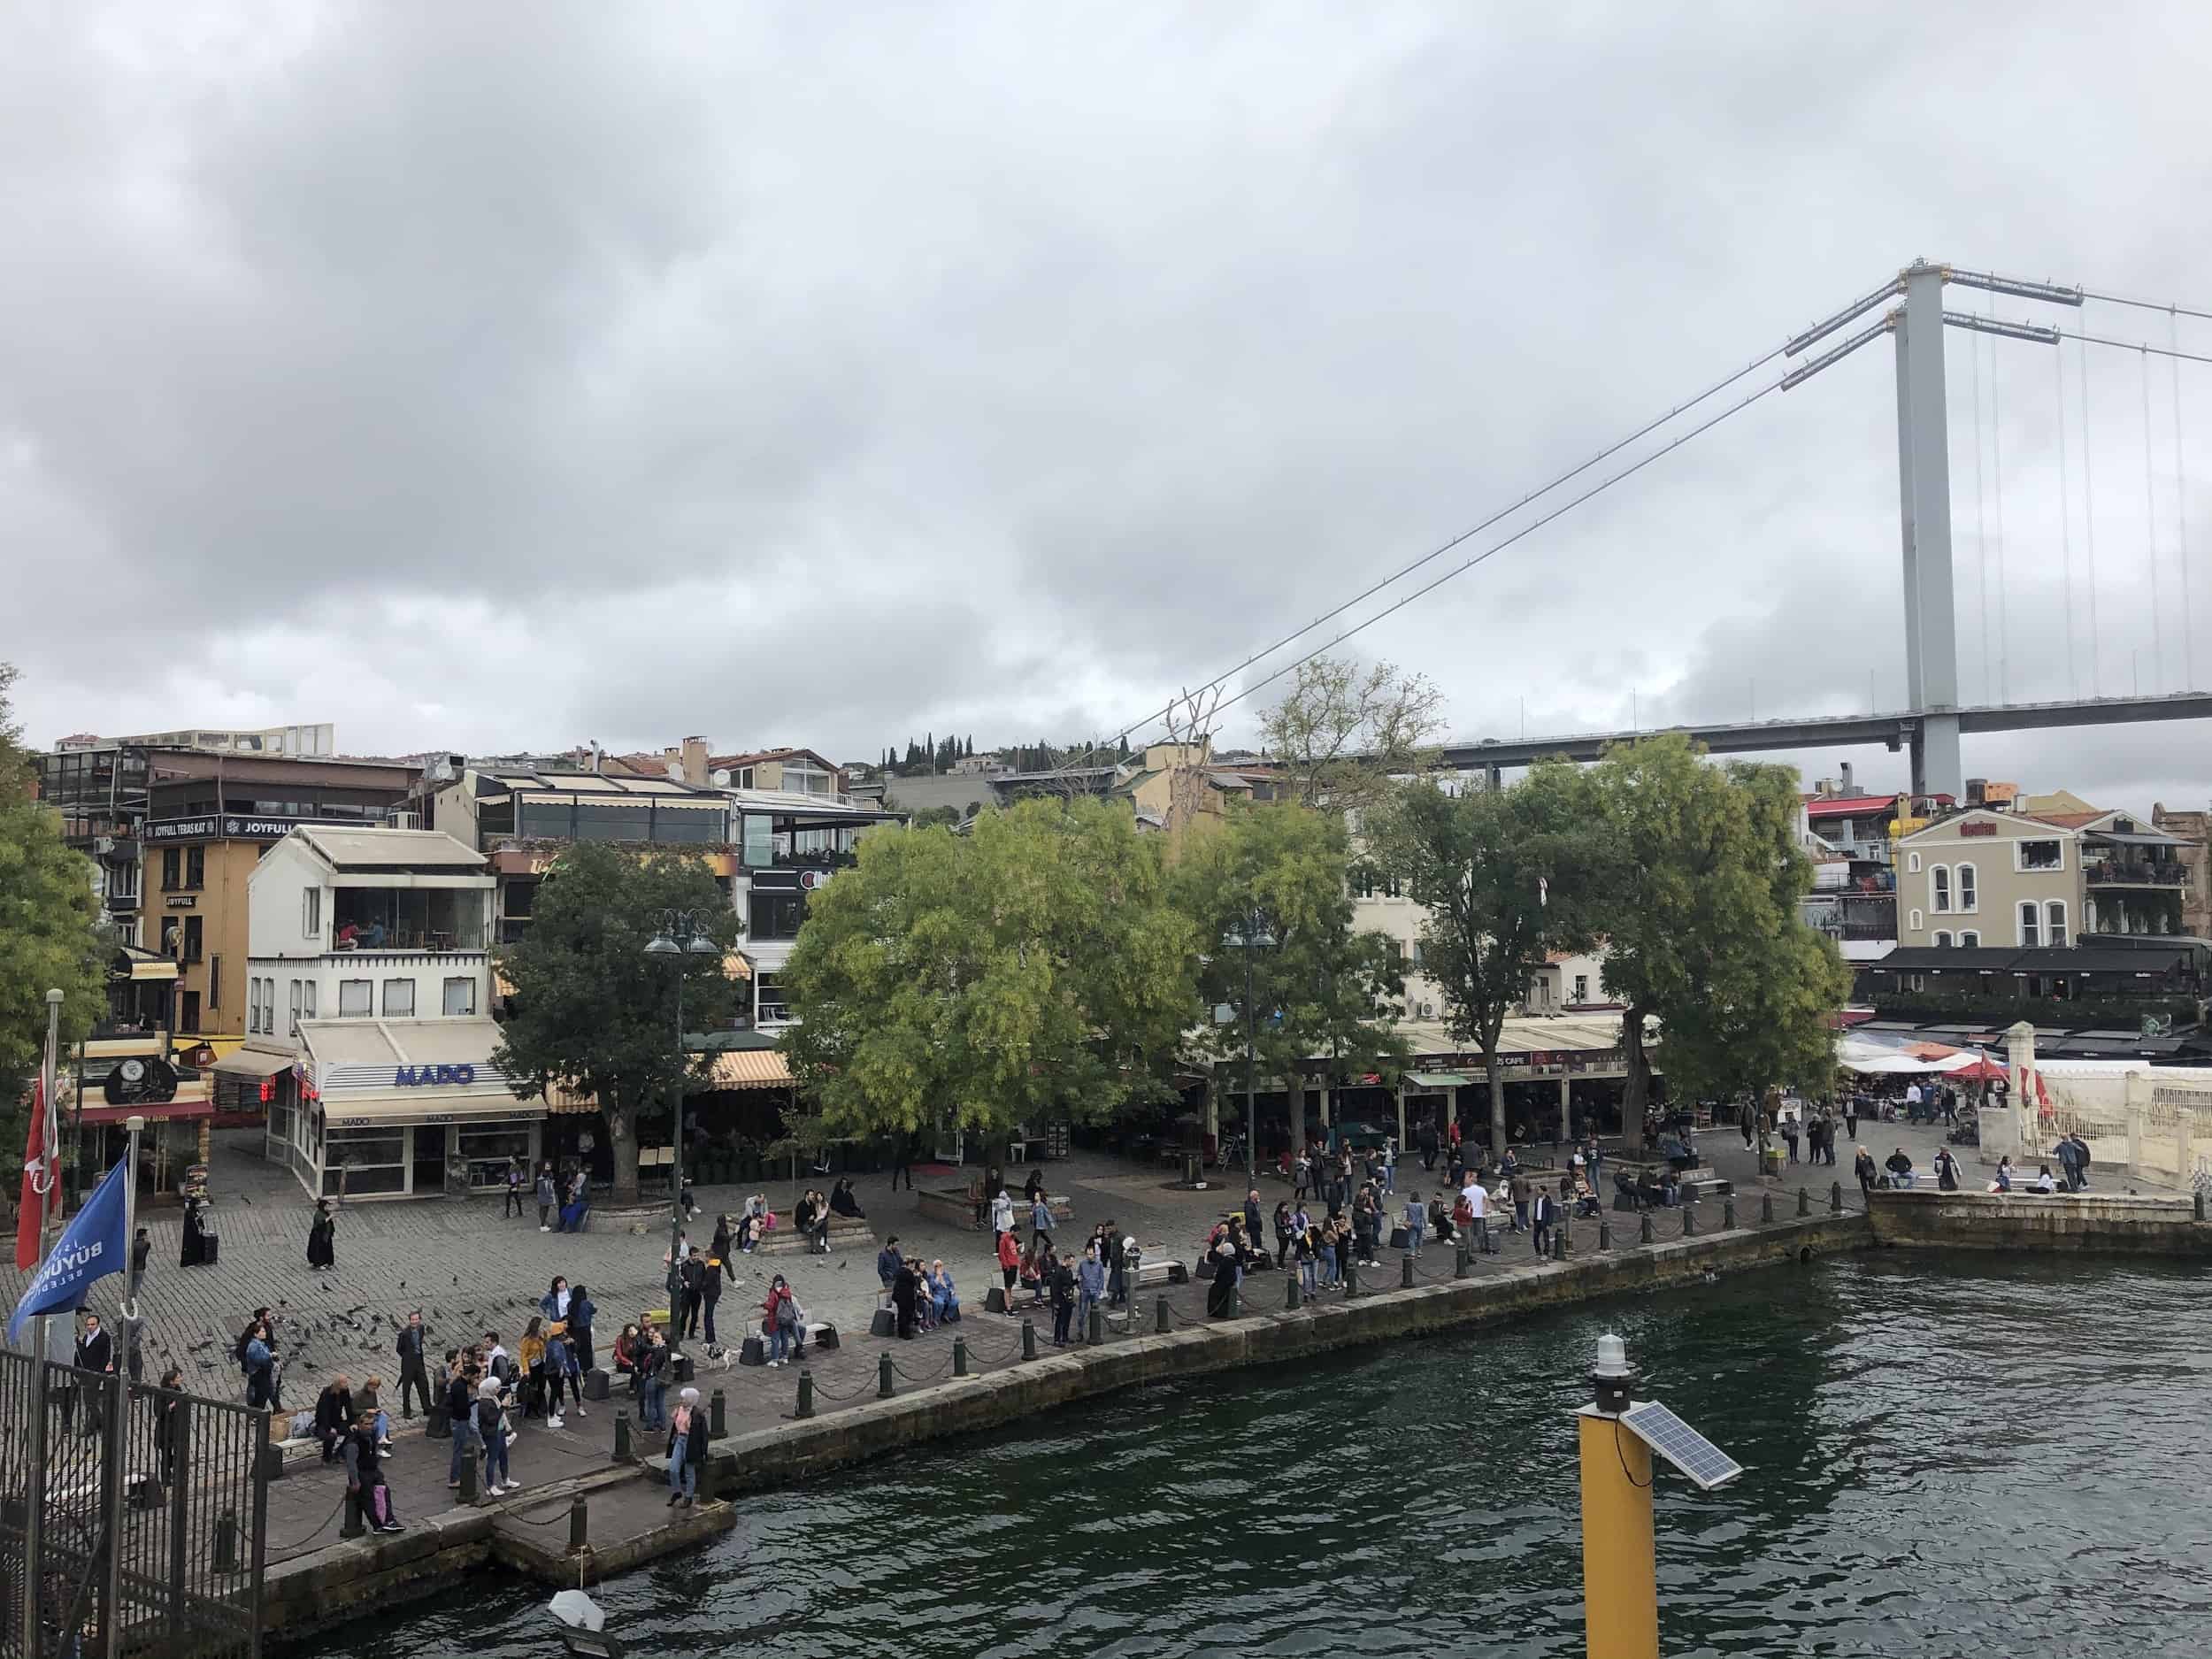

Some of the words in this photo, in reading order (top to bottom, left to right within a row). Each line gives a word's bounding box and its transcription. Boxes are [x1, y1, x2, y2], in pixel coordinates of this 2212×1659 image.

[155, 825, 177, 837] JOYFULL
[177, 823, 194, 835] TERAS
[194, 822, 206, 834] KAT
[396, 1064, 474, 1087] MADO
[341, 1118, 370, 1126] MADO
